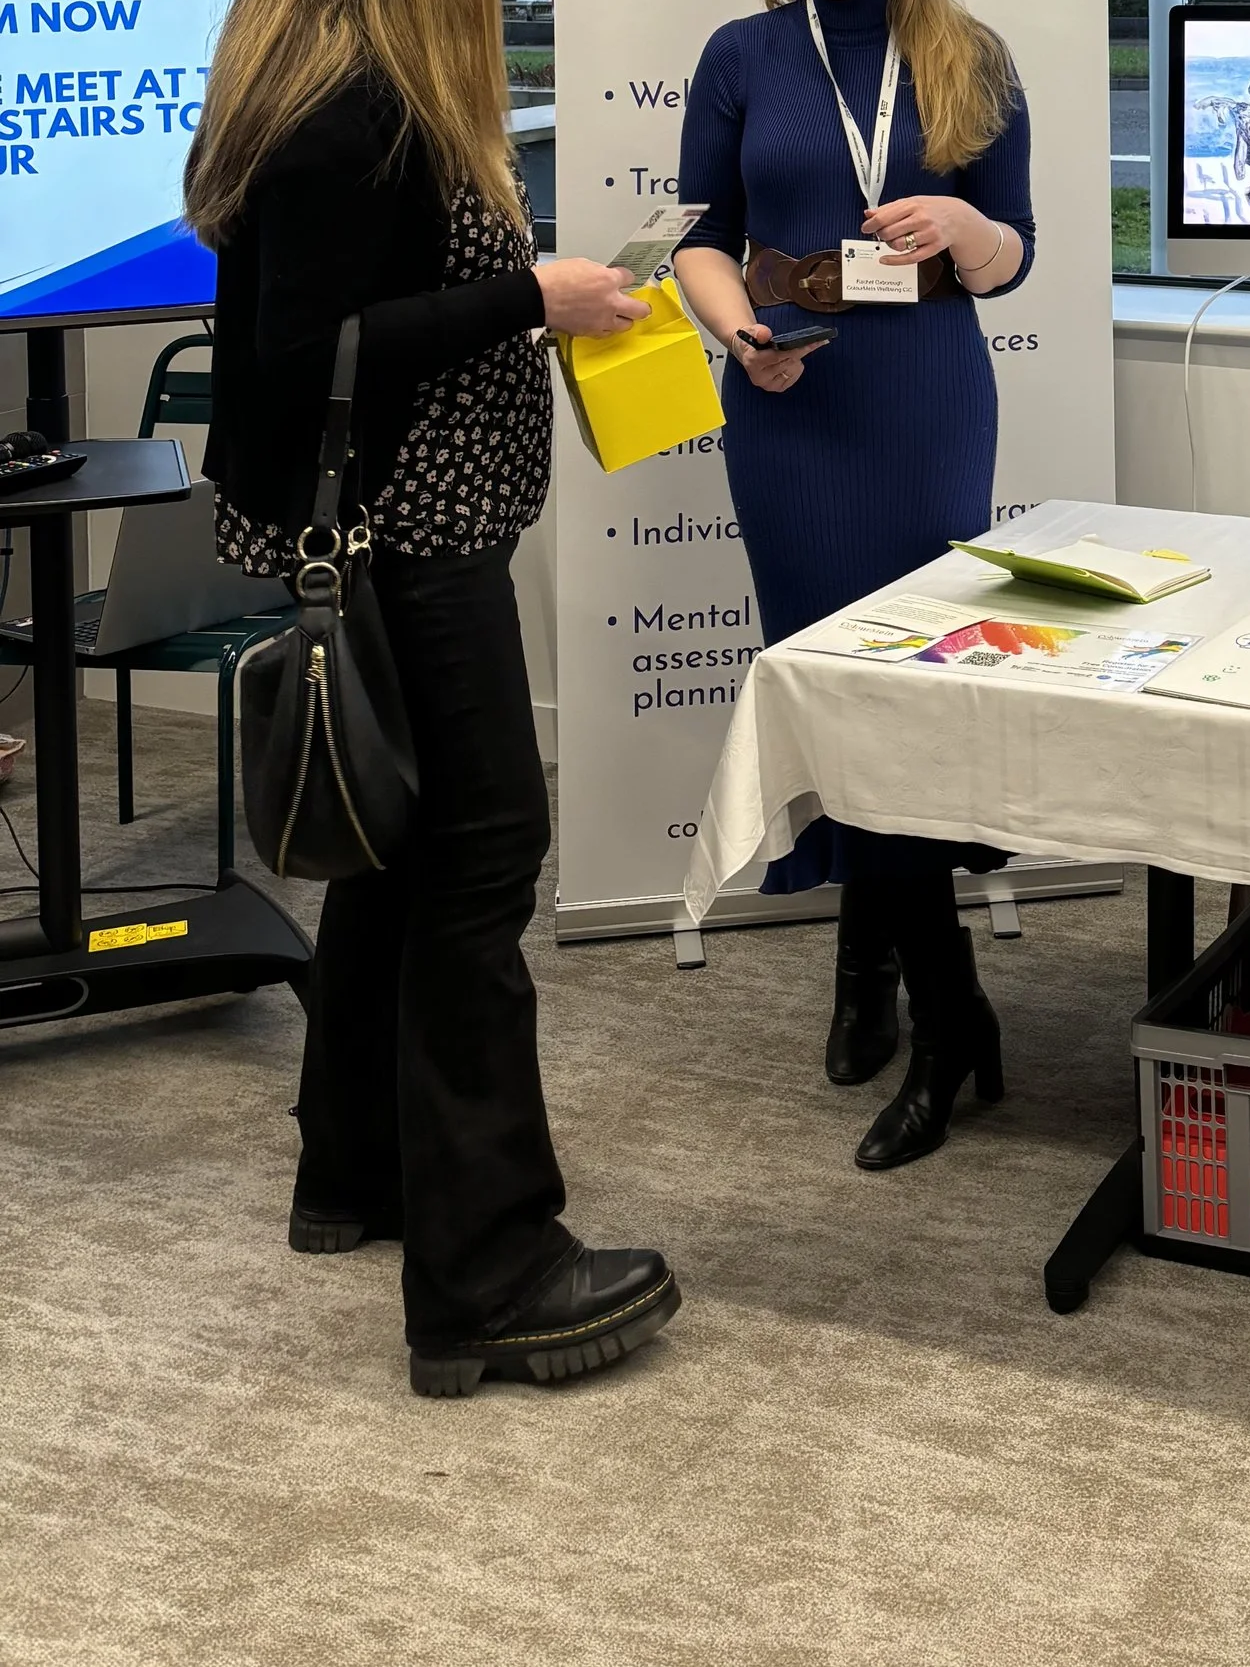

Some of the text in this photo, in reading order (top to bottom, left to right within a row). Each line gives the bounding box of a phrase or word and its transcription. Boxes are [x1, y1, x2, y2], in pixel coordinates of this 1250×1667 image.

[31, 0, 141, 33] NOW
[16, 69, 123, 104] MEET
[133, 67, 186, 99] AT
[628, 78, 689, 109] Wel
[0, 103, 144, 140] STAIRS
[634, 596, 749, 633] Mental
[633, 646, 765, 673] assessm
[633, 678, 737, 716] planni
